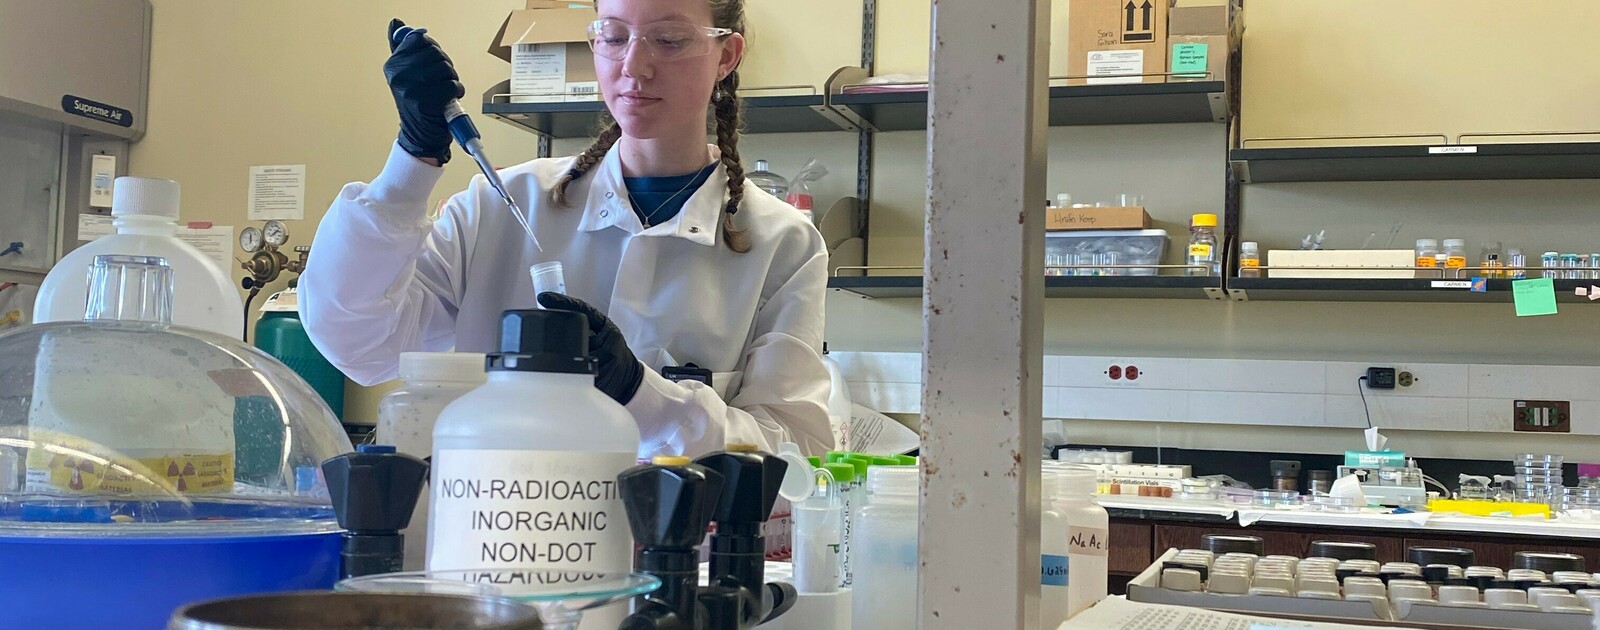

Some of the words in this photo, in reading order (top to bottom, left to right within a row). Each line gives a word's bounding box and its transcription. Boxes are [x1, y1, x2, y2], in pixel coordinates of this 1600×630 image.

[1097, 29, 1113, 38] Sara
[74, 100, 109, 117] Supreme
[111, 110, 122, 120] Air
[1079, 213, 1096, 225] Keep
[472, 511, 607, 531] INORGANIC
[481, 542, 597, 562] NON-DOT
